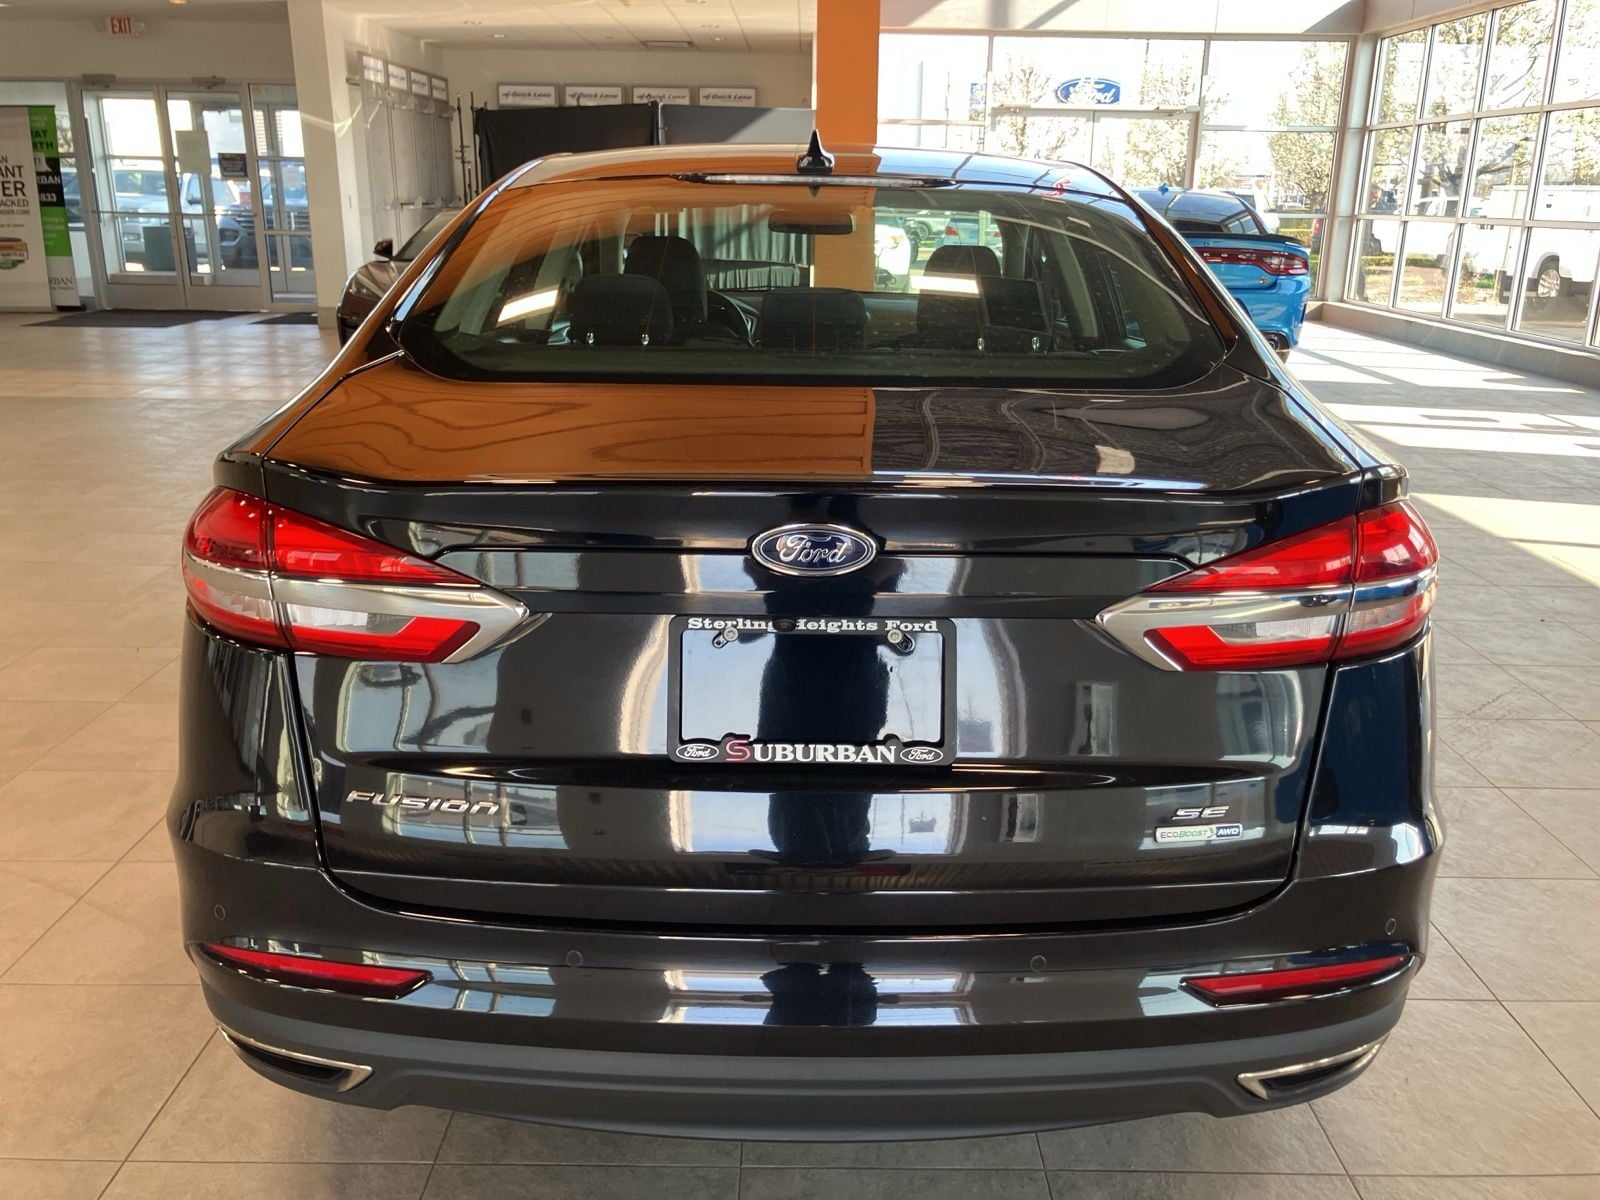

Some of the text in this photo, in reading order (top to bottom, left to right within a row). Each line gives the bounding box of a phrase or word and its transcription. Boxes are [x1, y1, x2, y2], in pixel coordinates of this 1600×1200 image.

[110, 16, 131, 34] EXIT
[1, 181, 26, 197] ER
[779, 534, 849, 563] Ford
[884, 619, 938, 632] Ford
[725, 738, 897, 763] SUBURBAN
[346, 790, 500, 815] FUSION
[1171, 806, 1230, 820] SE
[1217, 827, 1240, 837] AWD
